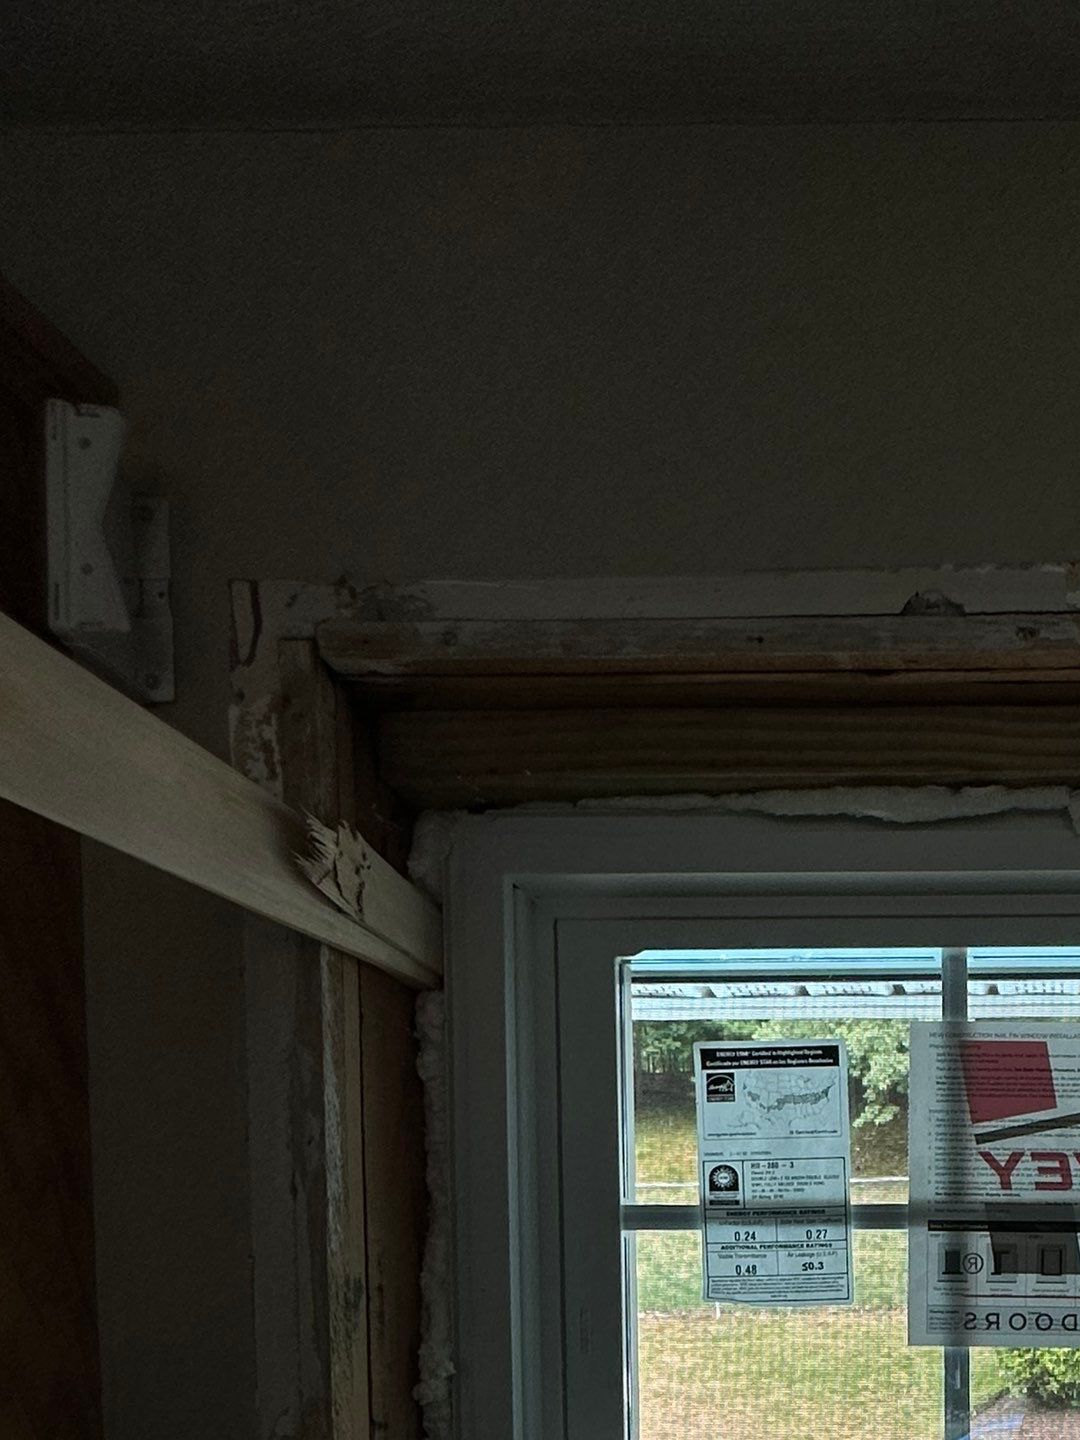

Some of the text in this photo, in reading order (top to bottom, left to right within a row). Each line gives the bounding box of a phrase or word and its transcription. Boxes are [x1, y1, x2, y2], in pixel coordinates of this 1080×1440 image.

[734, 1231, 757, 1242] 0.24
[806, 1229, 828, 1240] 0.27
[735, 1264, 757, 1275] 0.48
